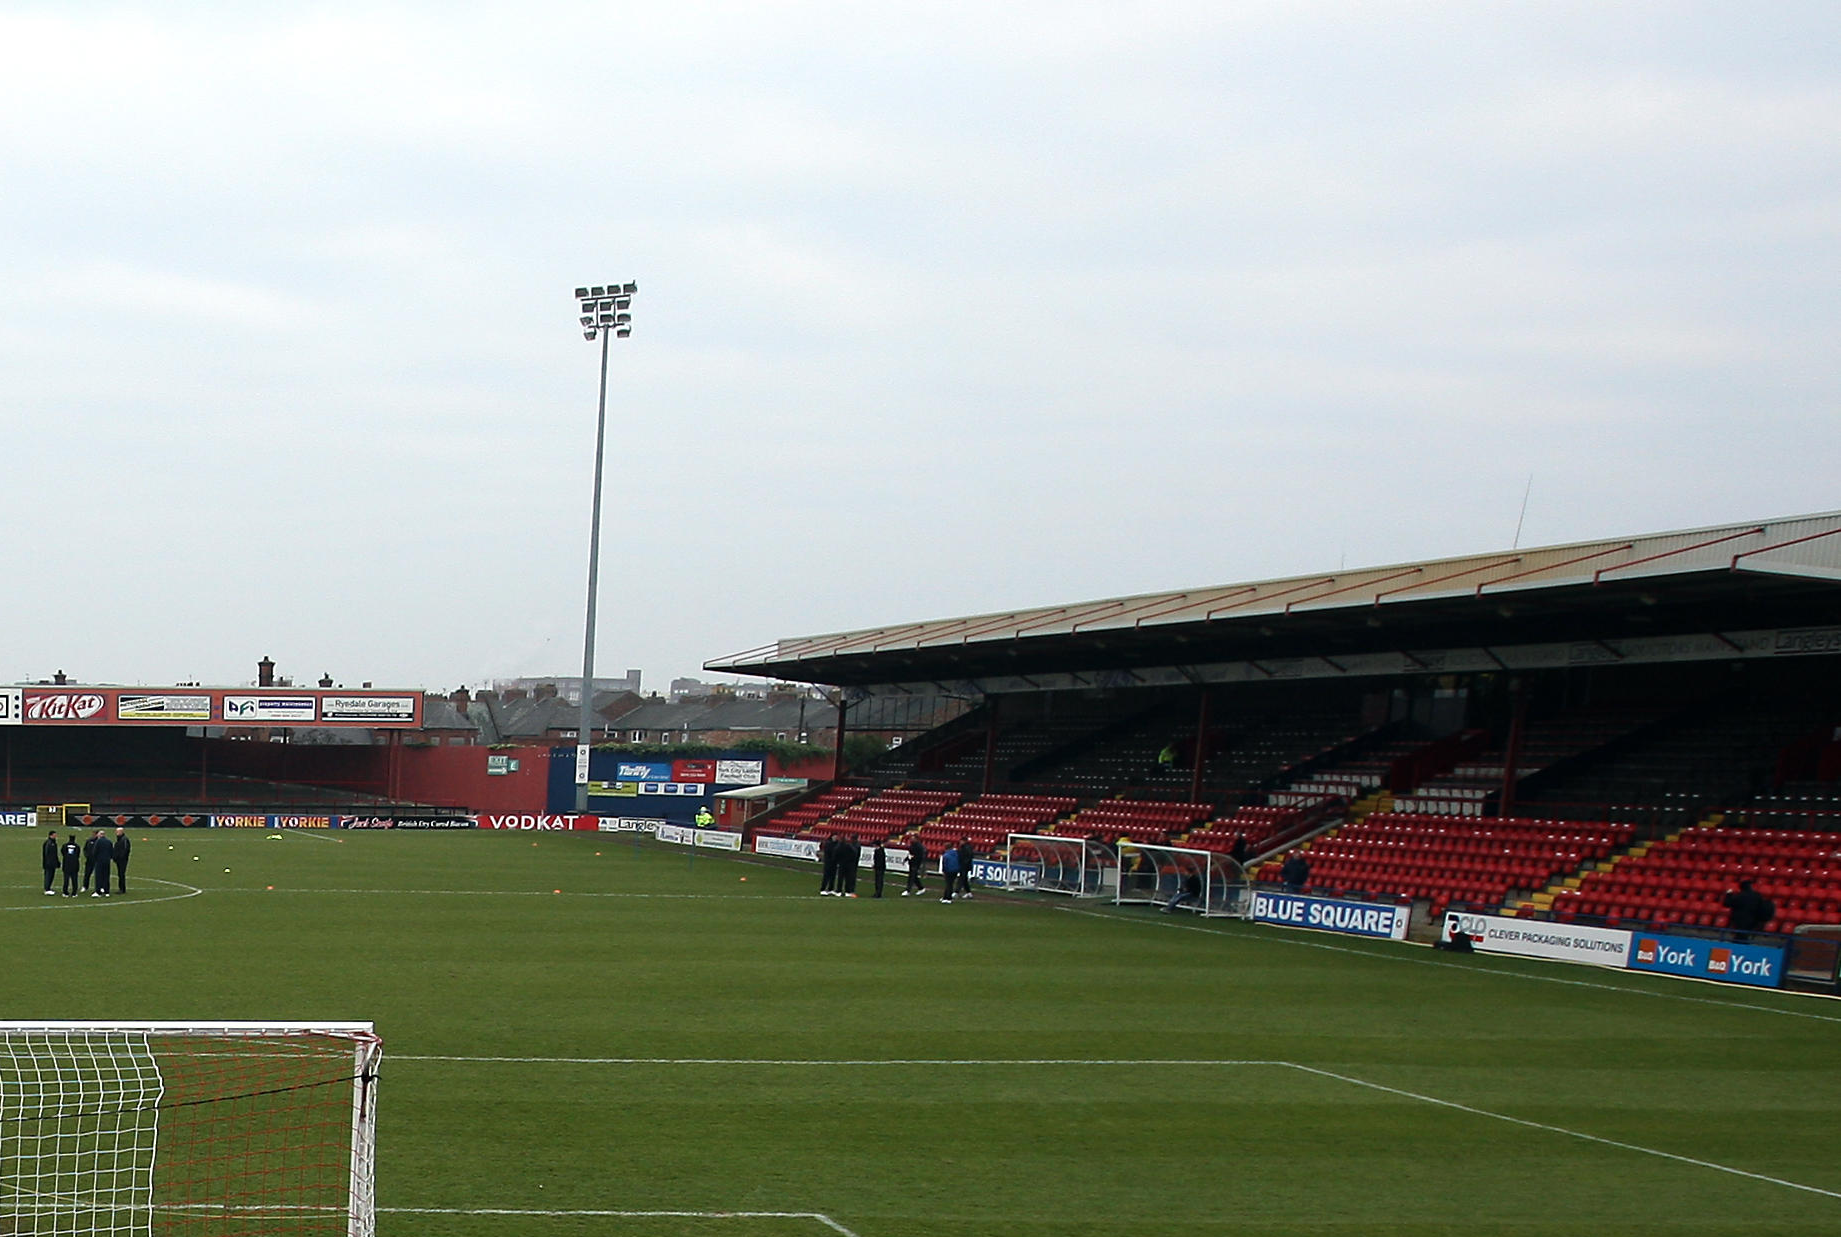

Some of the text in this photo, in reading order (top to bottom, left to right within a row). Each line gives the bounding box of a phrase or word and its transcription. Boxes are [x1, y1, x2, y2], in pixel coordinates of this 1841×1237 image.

[38, 695, 96, 720] KitKat
[335, 700, 401, 712] Ryedale Garages
[216, 815, 266, 827] YORKIE
[279, 816, 330, 828] YORKIE
[489, 815, 579, 830] VODKAT
[1256, 896, 1393, 934] BLUE SQUARE
[1488, 929, 1624, 953] CLEVER PACKAGING SOLUTIONS
[1658, 945, 1696, 968] York
[1731, 954, 1772, 978] York
